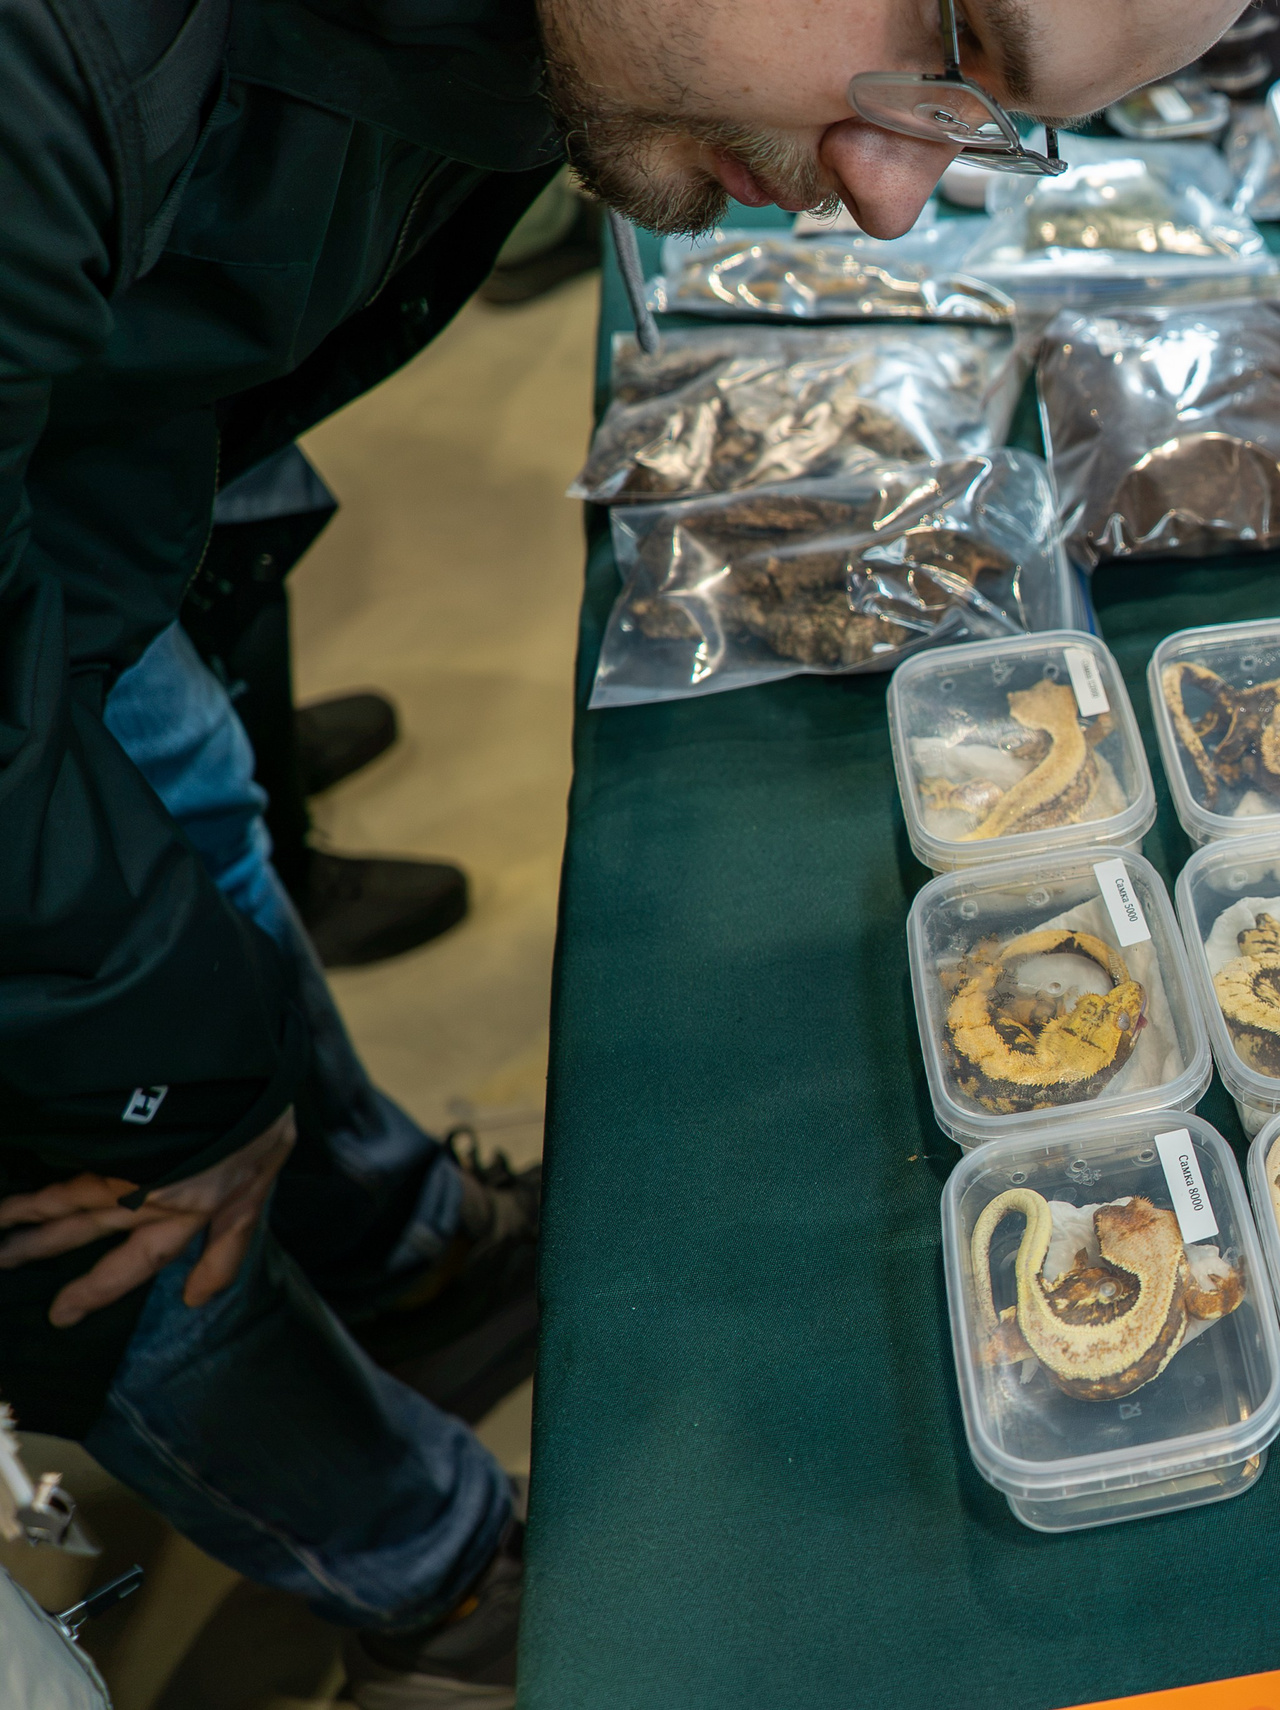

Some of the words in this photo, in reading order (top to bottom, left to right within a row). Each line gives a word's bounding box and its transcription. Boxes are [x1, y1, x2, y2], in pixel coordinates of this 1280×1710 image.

[1115, 878, 1129, 903] Самка
[1124, 903, 1138, 922] 5000
[1178, 1154, 1194, 1187] Самка
[1188, 1187, 1204, 1211] 8000
